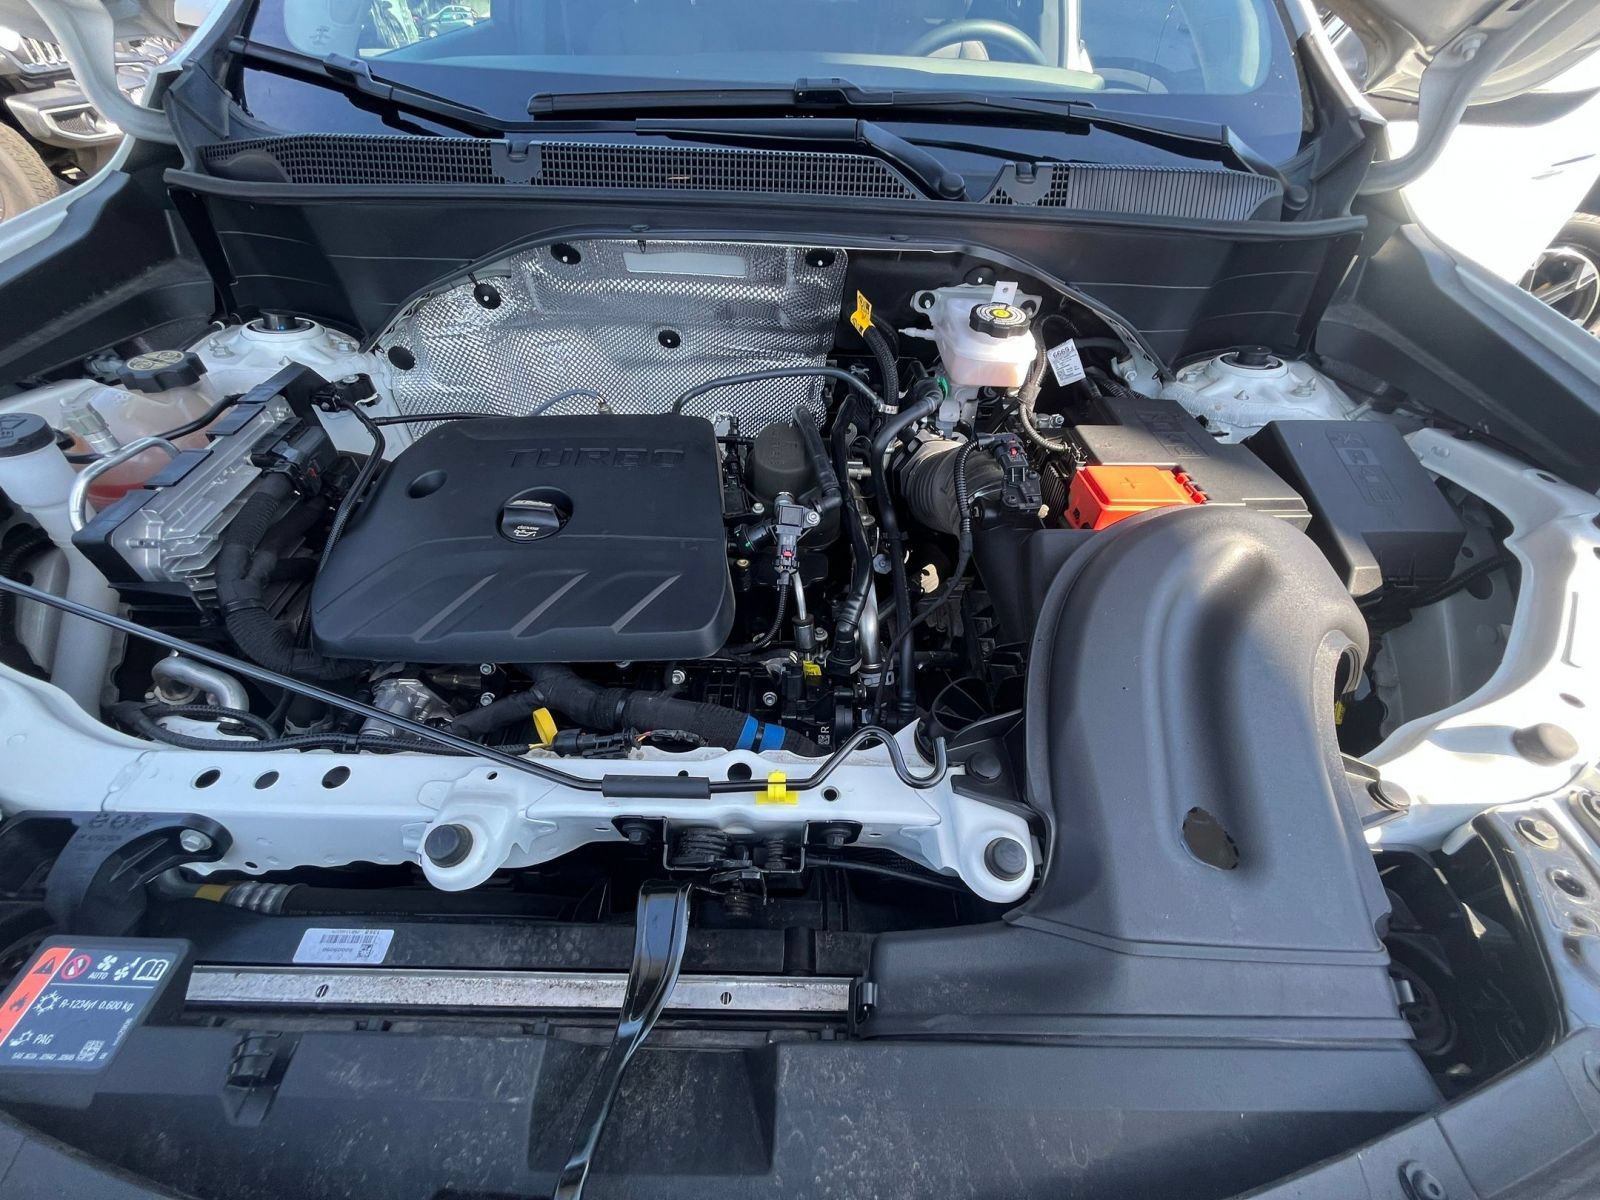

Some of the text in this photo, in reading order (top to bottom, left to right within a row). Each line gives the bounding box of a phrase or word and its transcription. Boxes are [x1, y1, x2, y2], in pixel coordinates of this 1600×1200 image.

[508, 447, 686, 468] TURBO
[88, 971, 109, 980] AUTO
[98, 1000, 123, 1011] 0.600
[121, 1001, 134, 1013] kg
[32, 1033, 54, 1045] PAG
